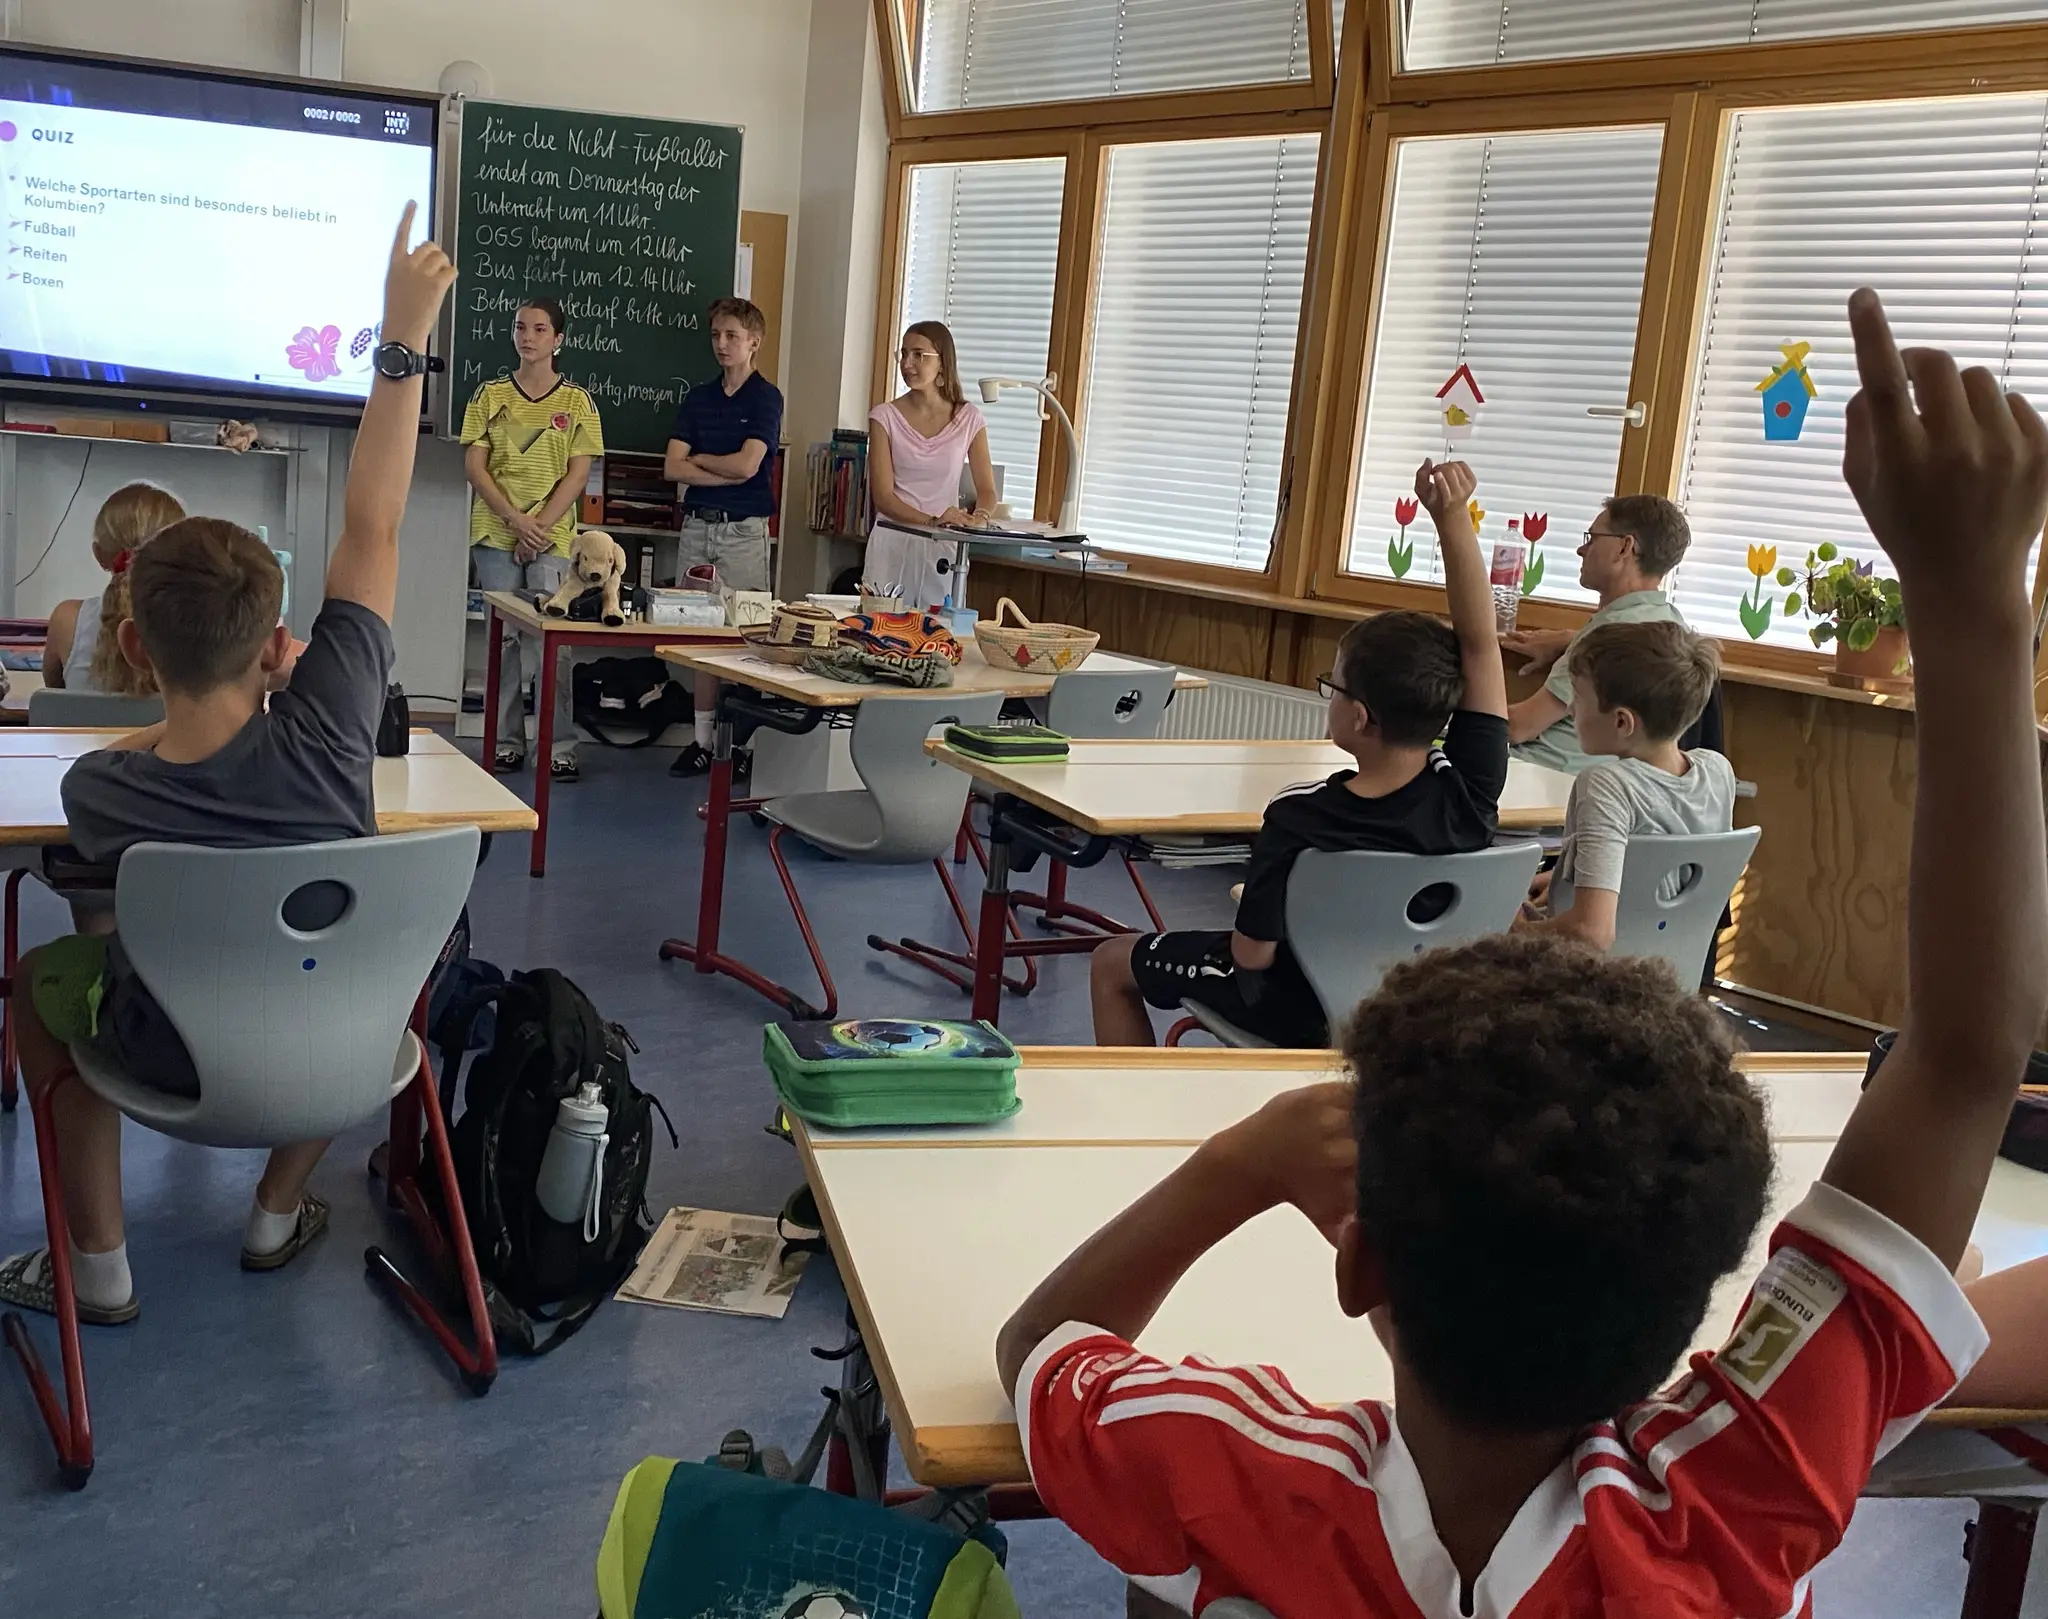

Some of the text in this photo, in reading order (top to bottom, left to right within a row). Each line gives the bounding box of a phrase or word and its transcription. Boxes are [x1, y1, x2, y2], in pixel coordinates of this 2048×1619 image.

[31, 127, 75, 145] QUIZ
[477, 116, 517, 153] für
[523, 121, 557, 151] die
[25, 175, 338, 224] Welche Sportarten sind besonders beliebt in
[474, 159, 701, 211] endet am Donnerstag der
[24, 194, 105, 215] Kolumbien?
[471, 191, 555, 222] Unterricht
[558, 204, 589, 224] um
[23, 220, 76, 239] Fußball
[475, 224, 523, 247] OGS
[529, 228, 592, 262] beginnt
[595, 236, 625, 257] um
[23, 245, 68, 264] Reiten
[473, 251, 516, 281] Bus
[522, 255, 568, 291] fährt
[572, 268, 603, 289] um
[22, 271, 64, 290] Boxen
[625, 297, 663, 327] bitte
[668, 312, 698, 331] ins
